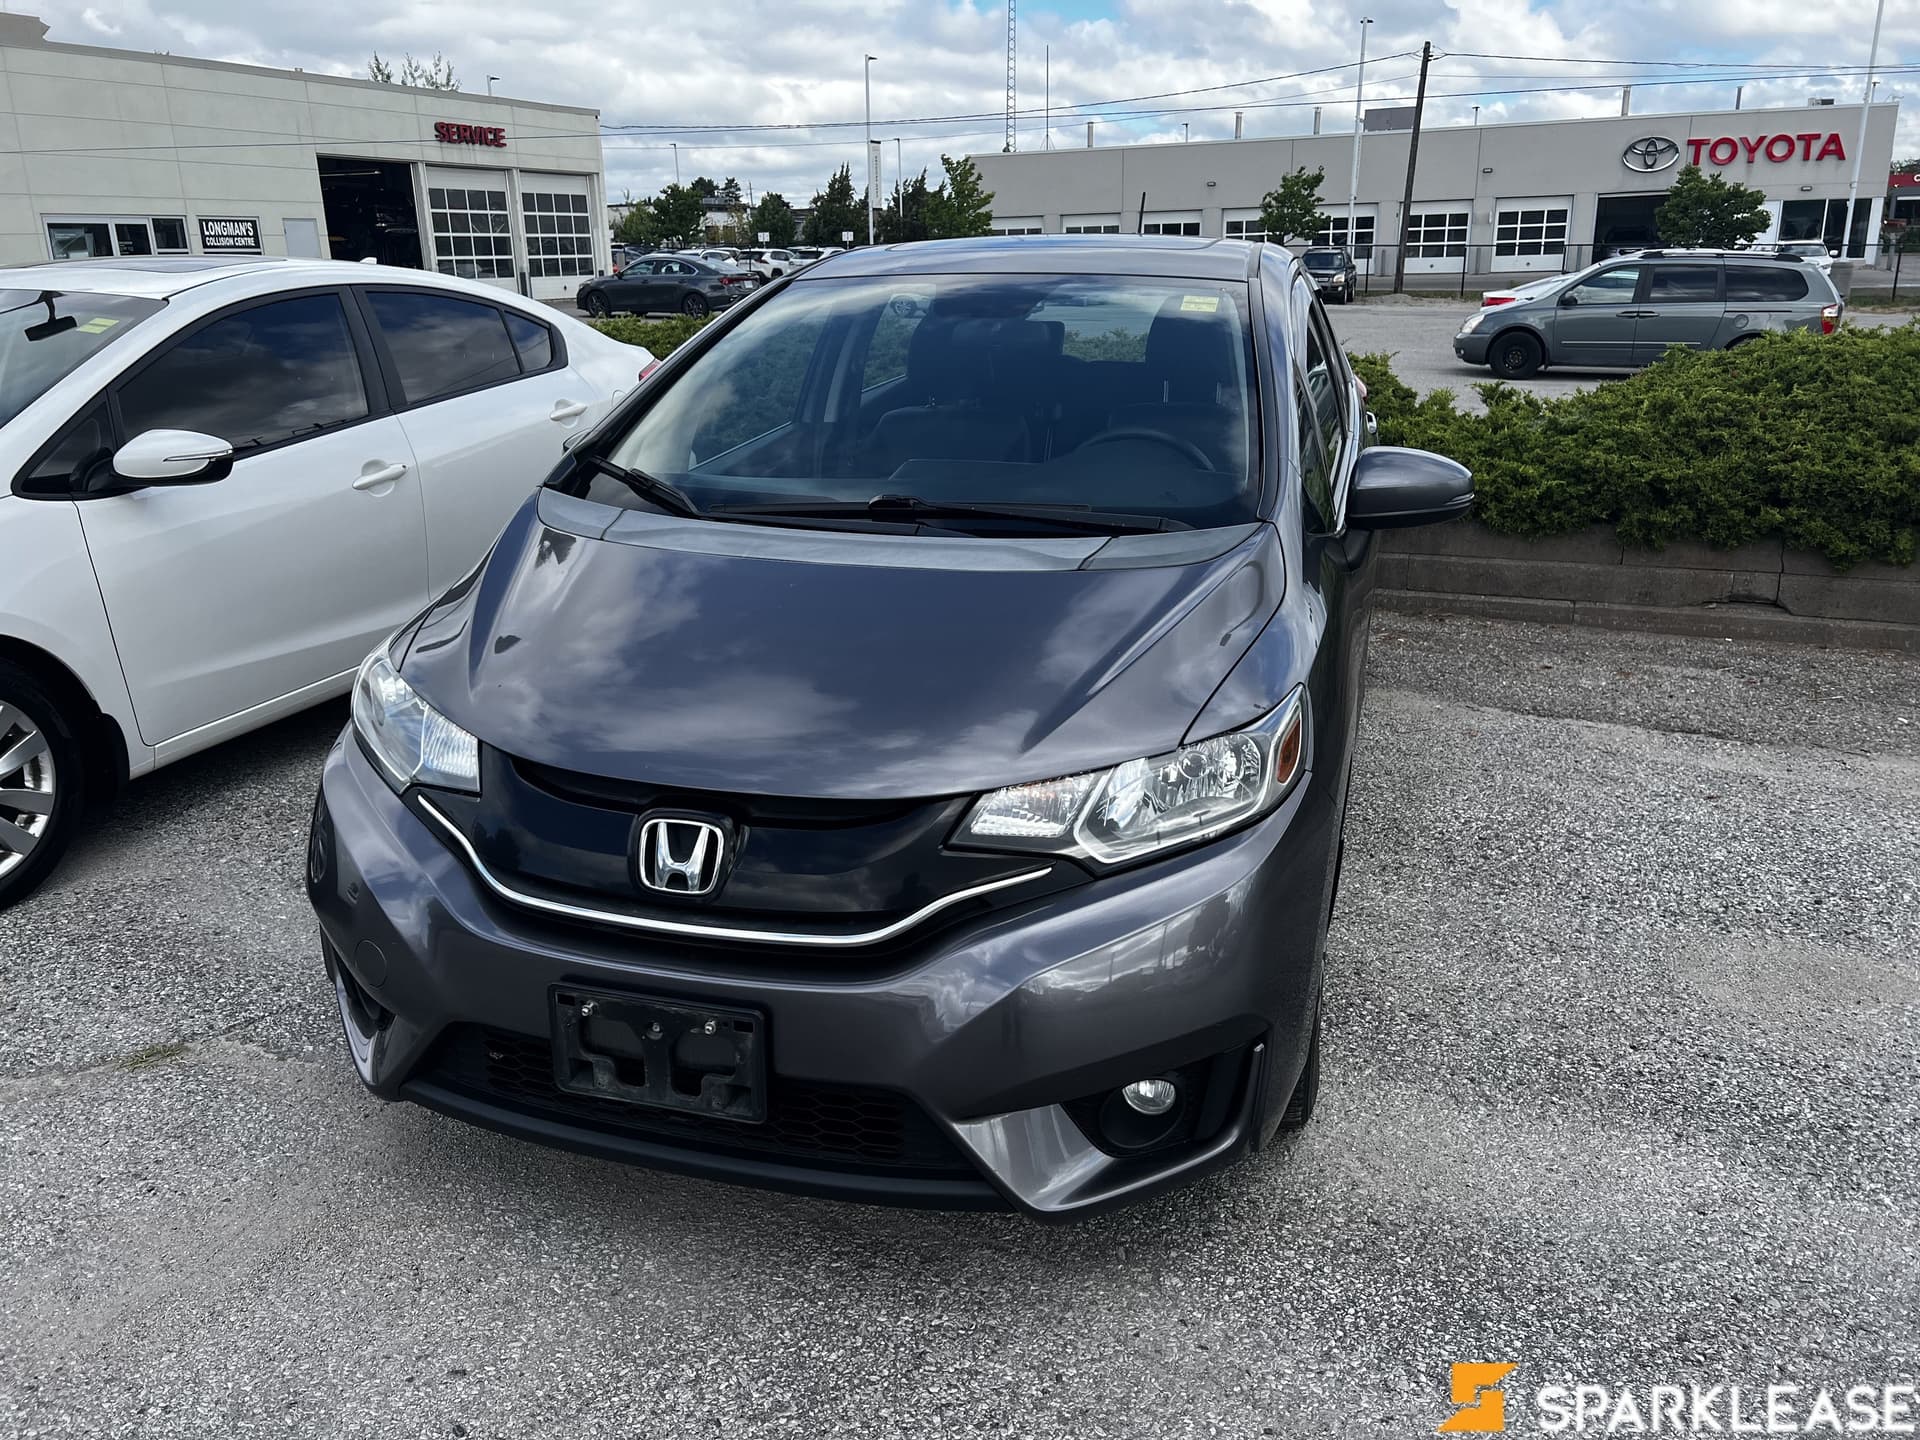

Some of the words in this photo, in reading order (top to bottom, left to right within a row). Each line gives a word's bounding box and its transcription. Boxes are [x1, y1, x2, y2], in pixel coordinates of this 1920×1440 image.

[434, 122, 507, 147] SERVICE
[1687, 133, 1846, 166] TOYOTA
[202, 221, 254, 236] LONGMAN'S
[205, 237, 234, 246] COLLISION
[234, 237, 256, 246] CENTRE
